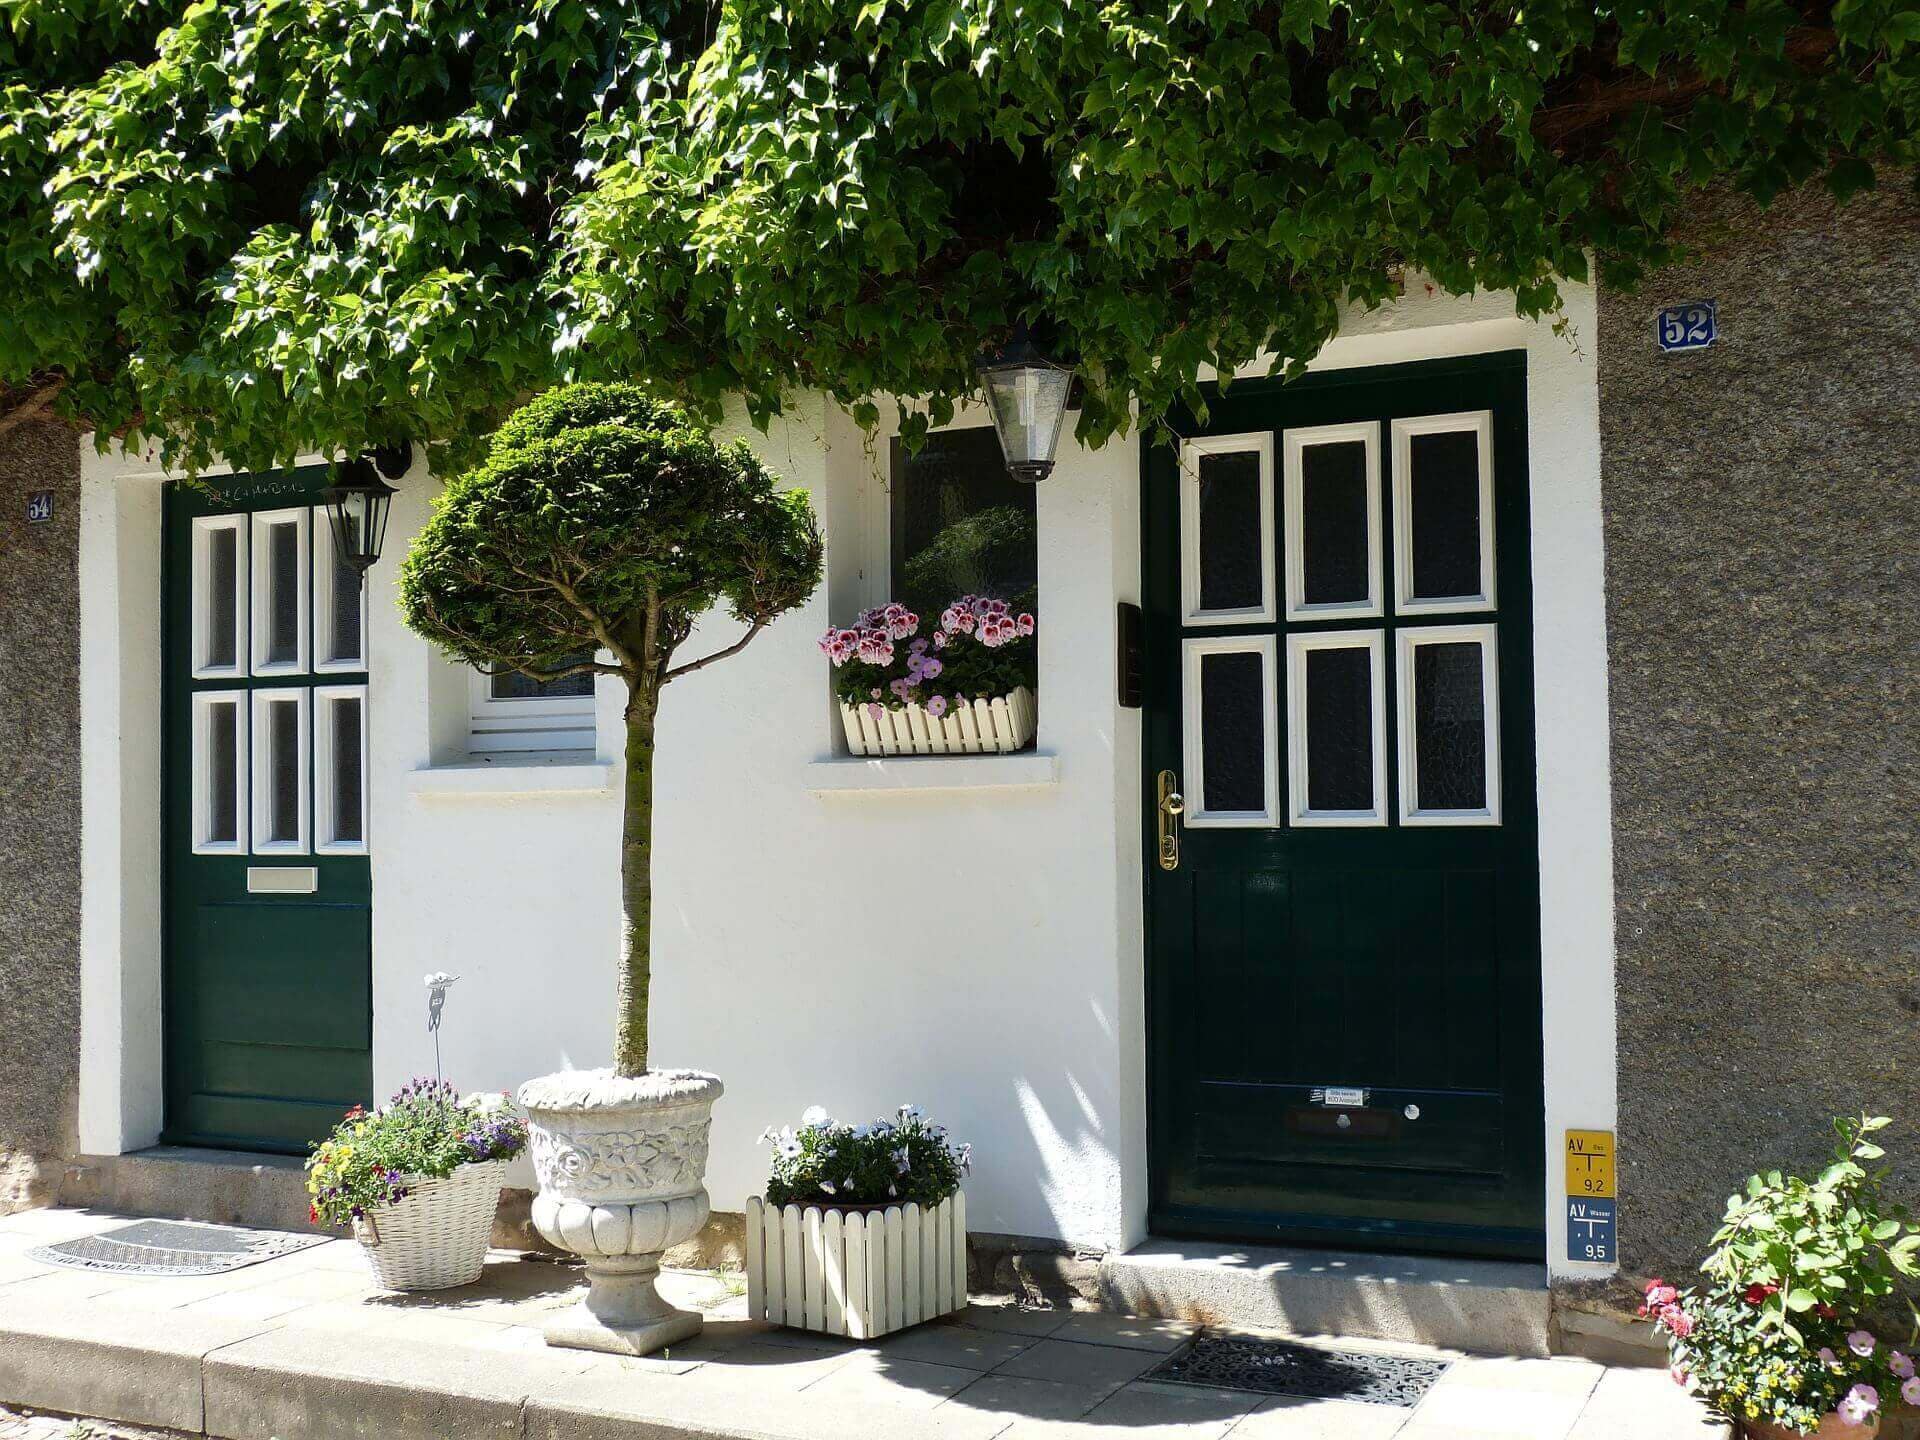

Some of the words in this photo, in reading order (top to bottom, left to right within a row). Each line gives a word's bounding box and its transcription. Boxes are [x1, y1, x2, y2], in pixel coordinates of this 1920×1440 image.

[1665, 309, 1708, 343] 52
[30, 494, 50, 519] 54
[1568, 1137, 1584, 1151] AV
[1569, 1203, 1586, 1217] AV
